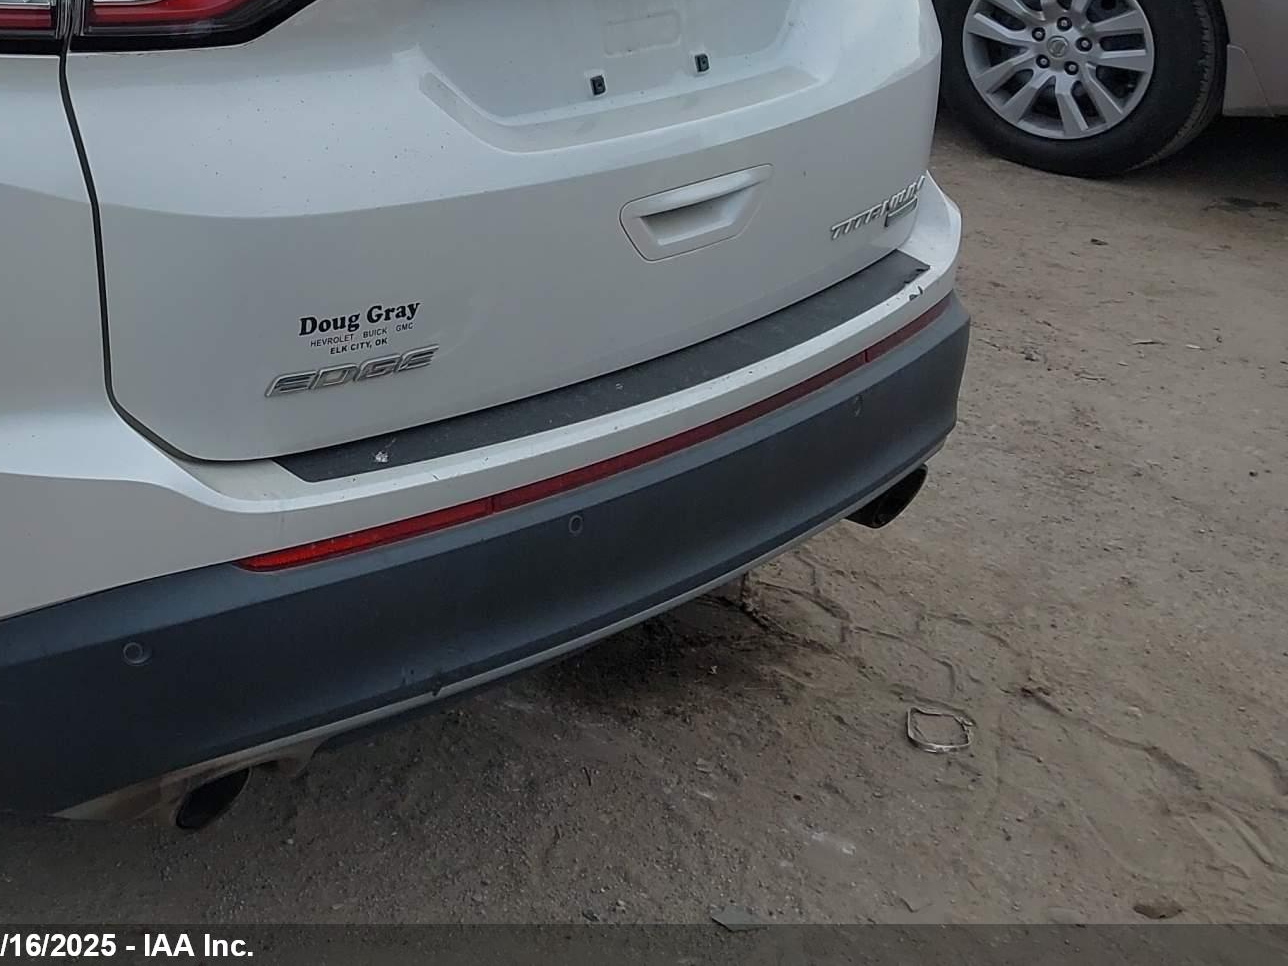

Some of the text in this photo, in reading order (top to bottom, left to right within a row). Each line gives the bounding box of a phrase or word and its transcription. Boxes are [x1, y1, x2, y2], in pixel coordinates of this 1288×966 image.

[299, 302, 421, 336] Doug Gray
[362, 327, 388, 339] BUICK
[395, 322, 414, 332] GMC
[329, 337, 388, 355] ELK CITY, OK
[264, 343, 439, 398] EDGE
